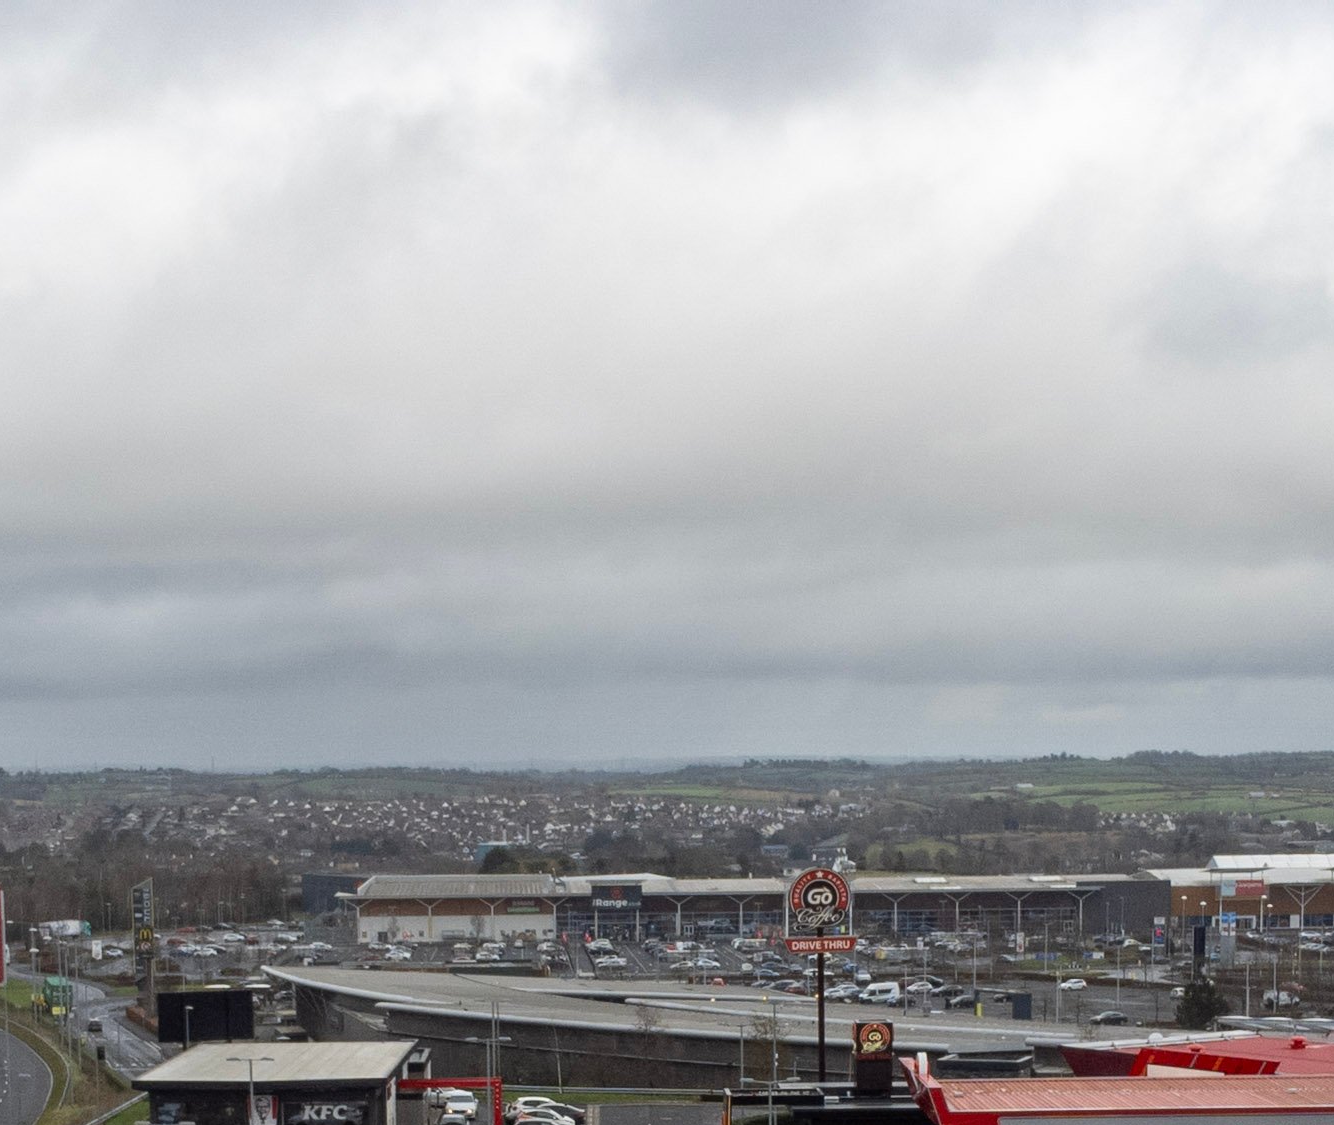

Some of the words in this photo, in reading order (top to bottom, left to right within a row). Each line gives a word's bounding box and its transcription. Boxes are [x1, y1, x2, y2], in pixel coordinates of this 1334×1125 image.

[793, 905, 845, 932] Coffee
[791, 941, 822, 950] DRIVE
[824, 940, 850, 949] THRU
[302, 1105, 348, 1120] KFC
